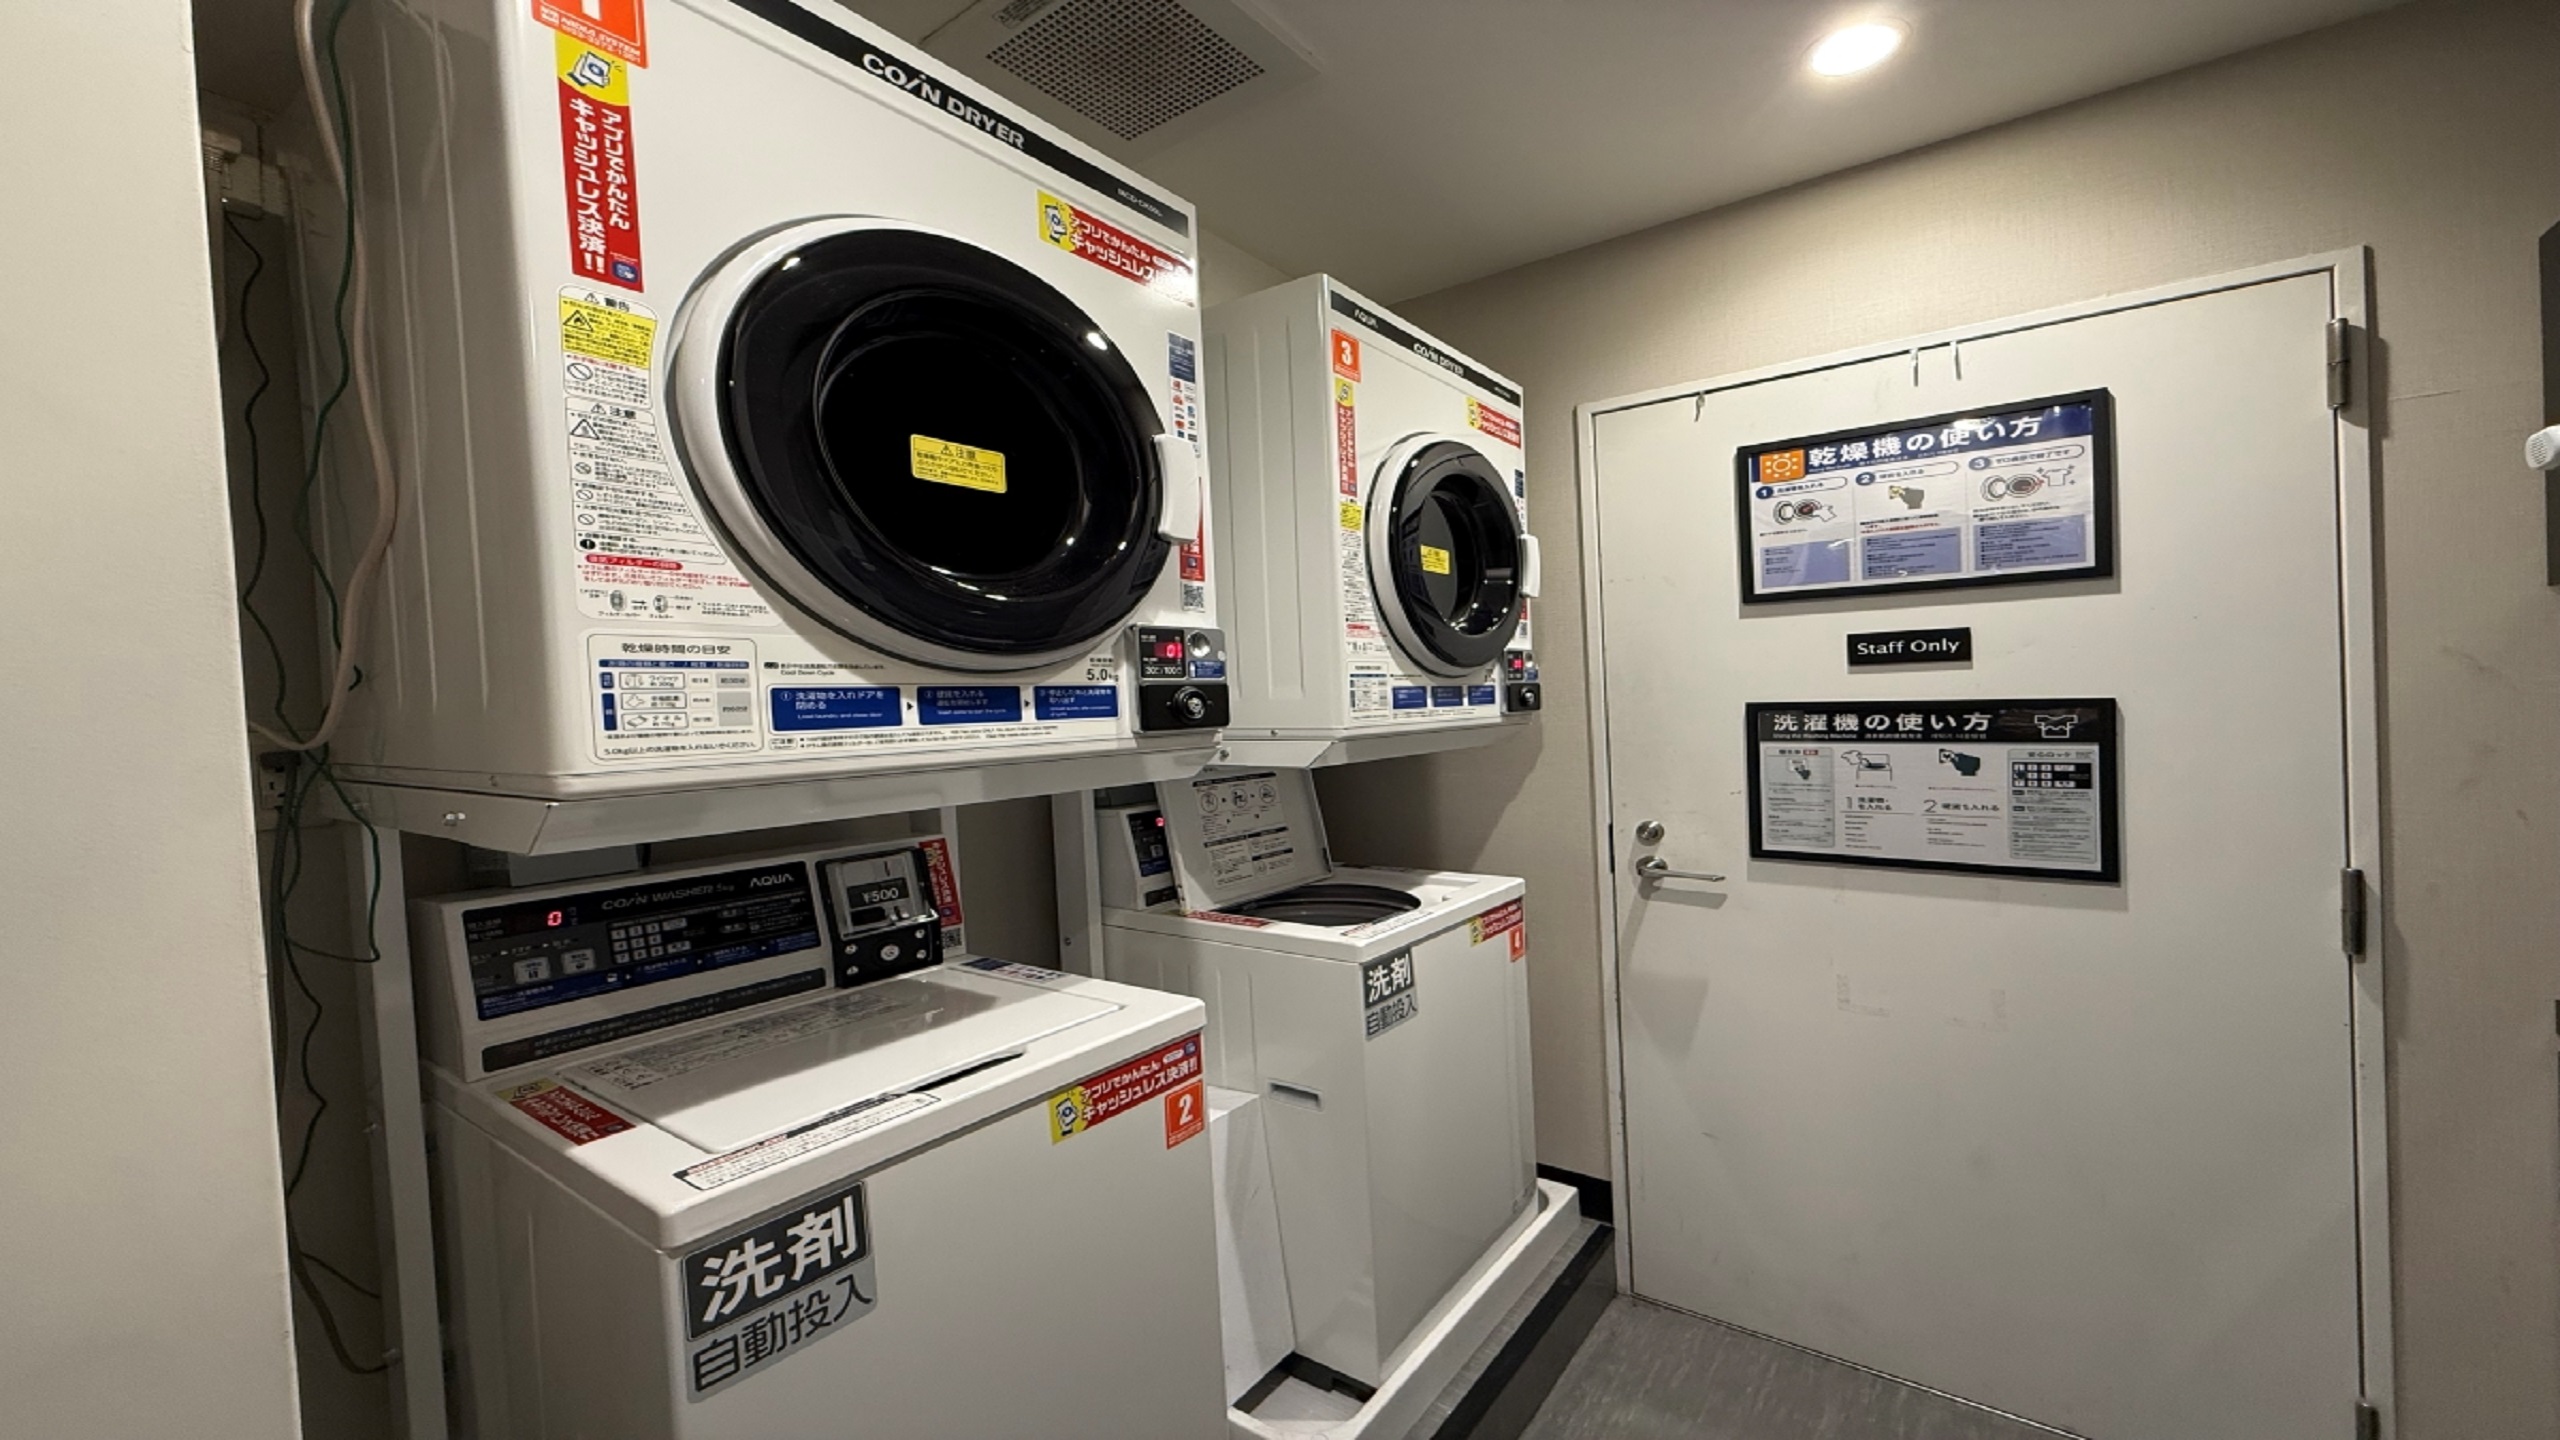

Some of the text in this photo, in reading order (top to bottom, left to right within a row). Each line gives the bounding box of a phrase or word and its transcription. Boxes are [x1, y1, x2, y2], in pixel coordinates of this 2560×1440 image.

[947, 97, 1025, 150] DRYER
[601, 108, 631, 230] アプリでかんたん
[1069, 213, 1151, 266] アプリでかんたん
[1341, 340, 1353, 366] 3
[1439, 355, 1464, 377] DRYER
[1808, 415, 2042, 468] 乾燥機の使い方
[621, 643, 731, 655] 乾燥時間の目安
[1857, 638, 1961, 656] Staff Only
[1772, 712, 1993, 733] 洗濯機の使い方
[1923, 799, 1938, 813] 2
[652, 884, 715, 902] WASHER
[749, 873, 794, 888] AQUA
[862, 887, 899, 903] ¥500
[547, 910, 562, 926] 0
[1367, 953, 1411, 1003] 洗剤
[1366, 993, 1418, 1036] 自動投入
[1081, 1060, 1161, 1099] アプリでかんたん
[1178, 1093, 1194, 1126] 2
[700, 1195, 858, 1323] 洗剤
[693, 1273, 874, 1392] 自動投入
